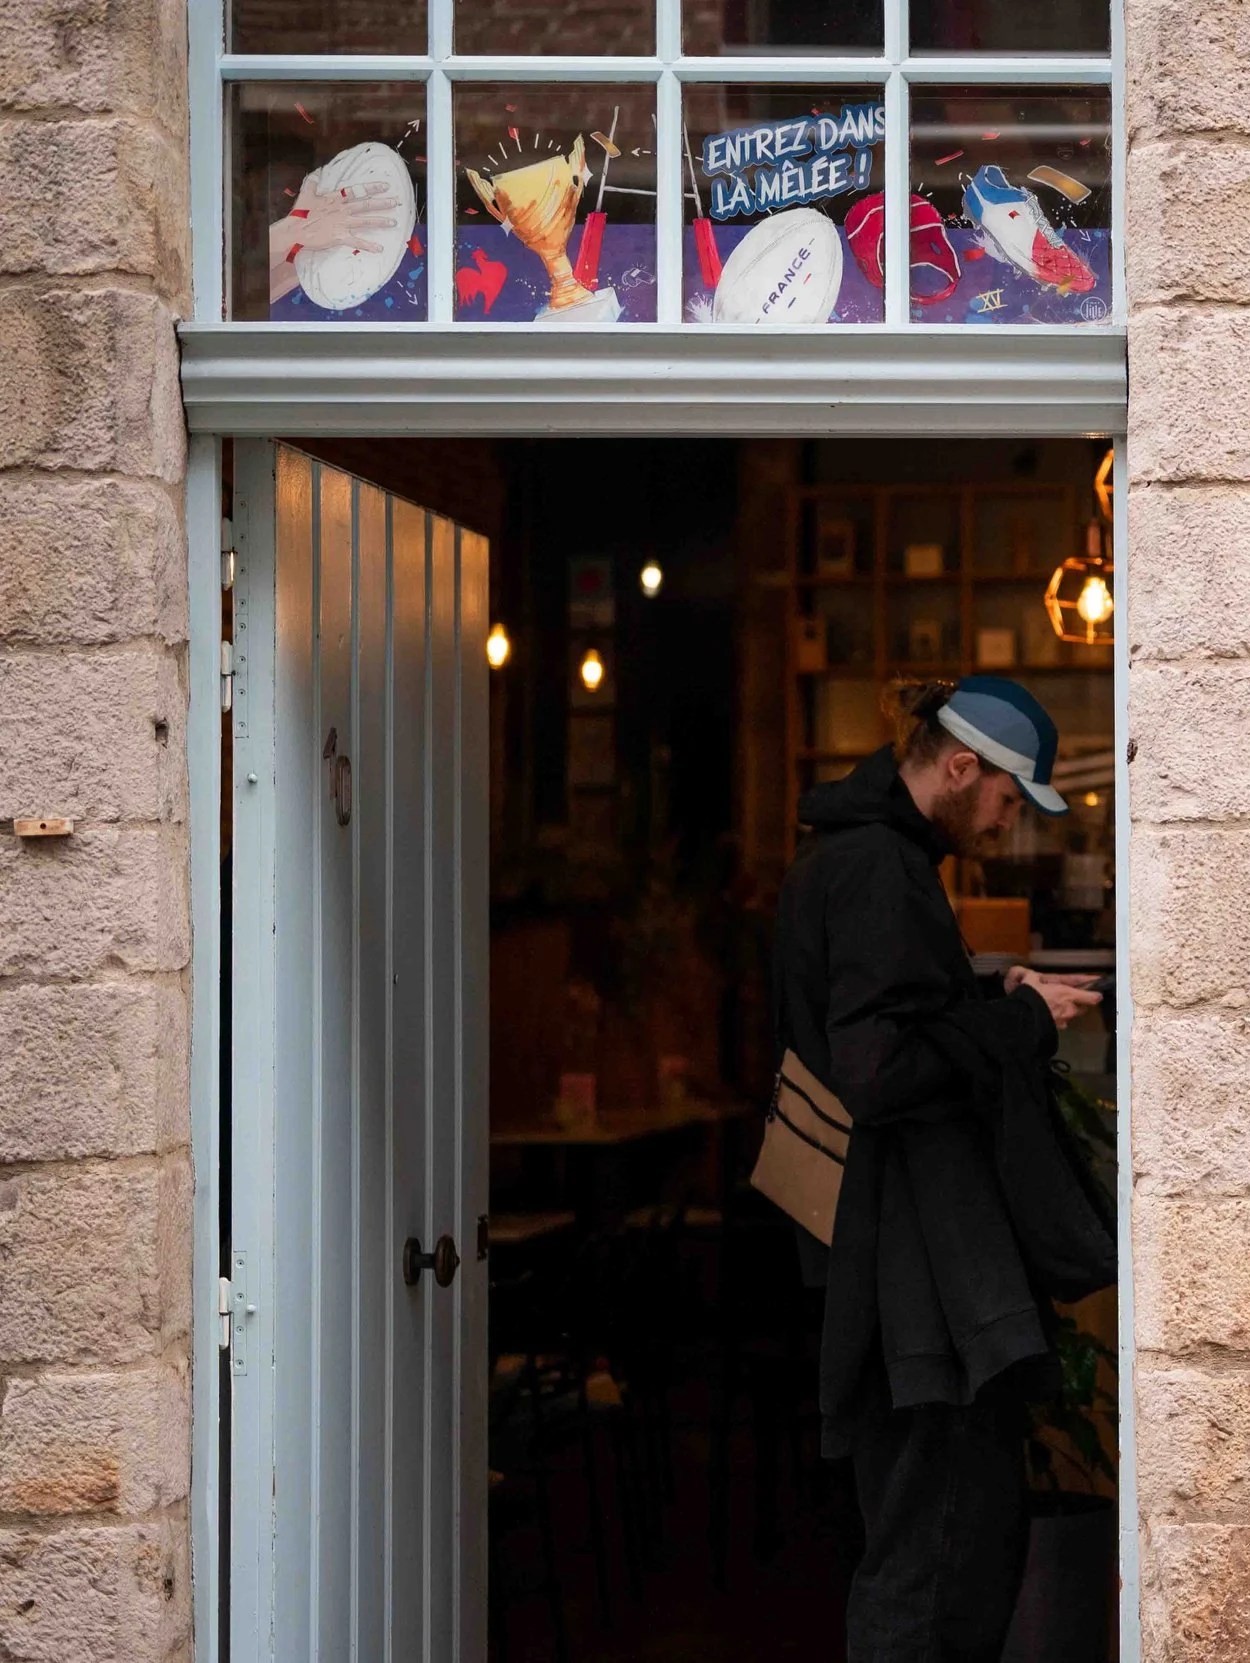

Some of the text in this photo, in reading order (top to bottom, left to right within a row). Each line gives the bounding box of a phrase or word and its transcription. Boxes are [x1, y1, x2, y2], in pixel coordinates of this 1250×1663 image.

[709, 106, 885, 170] ENTREZ DANS
[715, 153, 867, 214] LA MÊLÉE !
[762, 248, 811, 314] FRANCE
[976, 289, 1008, 313] XV
